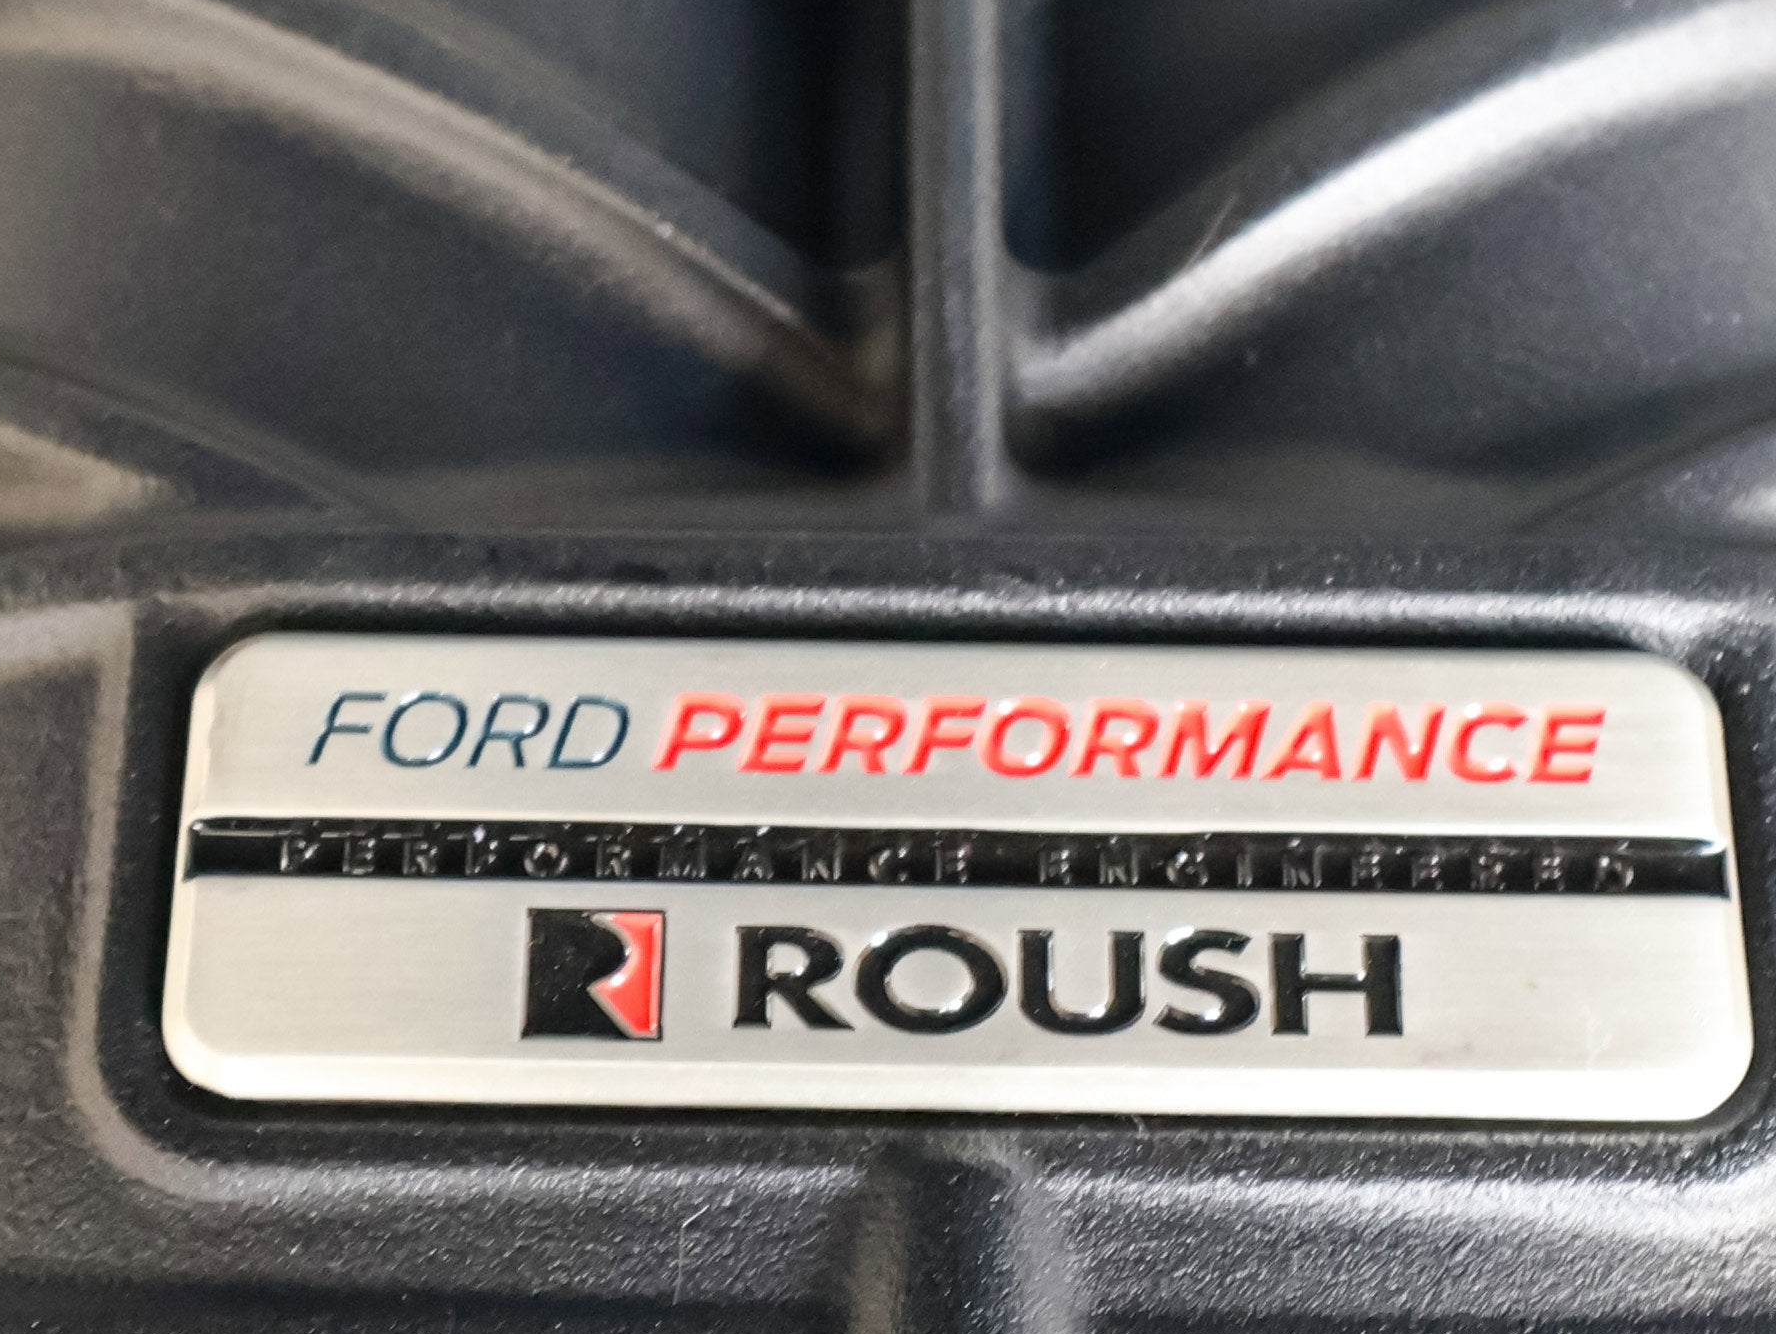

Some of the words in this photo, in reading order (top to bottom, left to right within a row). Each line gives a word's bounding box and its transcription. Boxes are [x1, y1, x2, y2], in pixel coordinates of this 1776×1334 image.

[307, 691, 630, 768] FORD
[652, 691, 1607, 784] PERFORMANCE
[278, 829, 971, 885] PERFORMANCE
[1037, 837, 1636, 892] ENGINEERED
[731, 924, 1405, 1037] ROUSH
